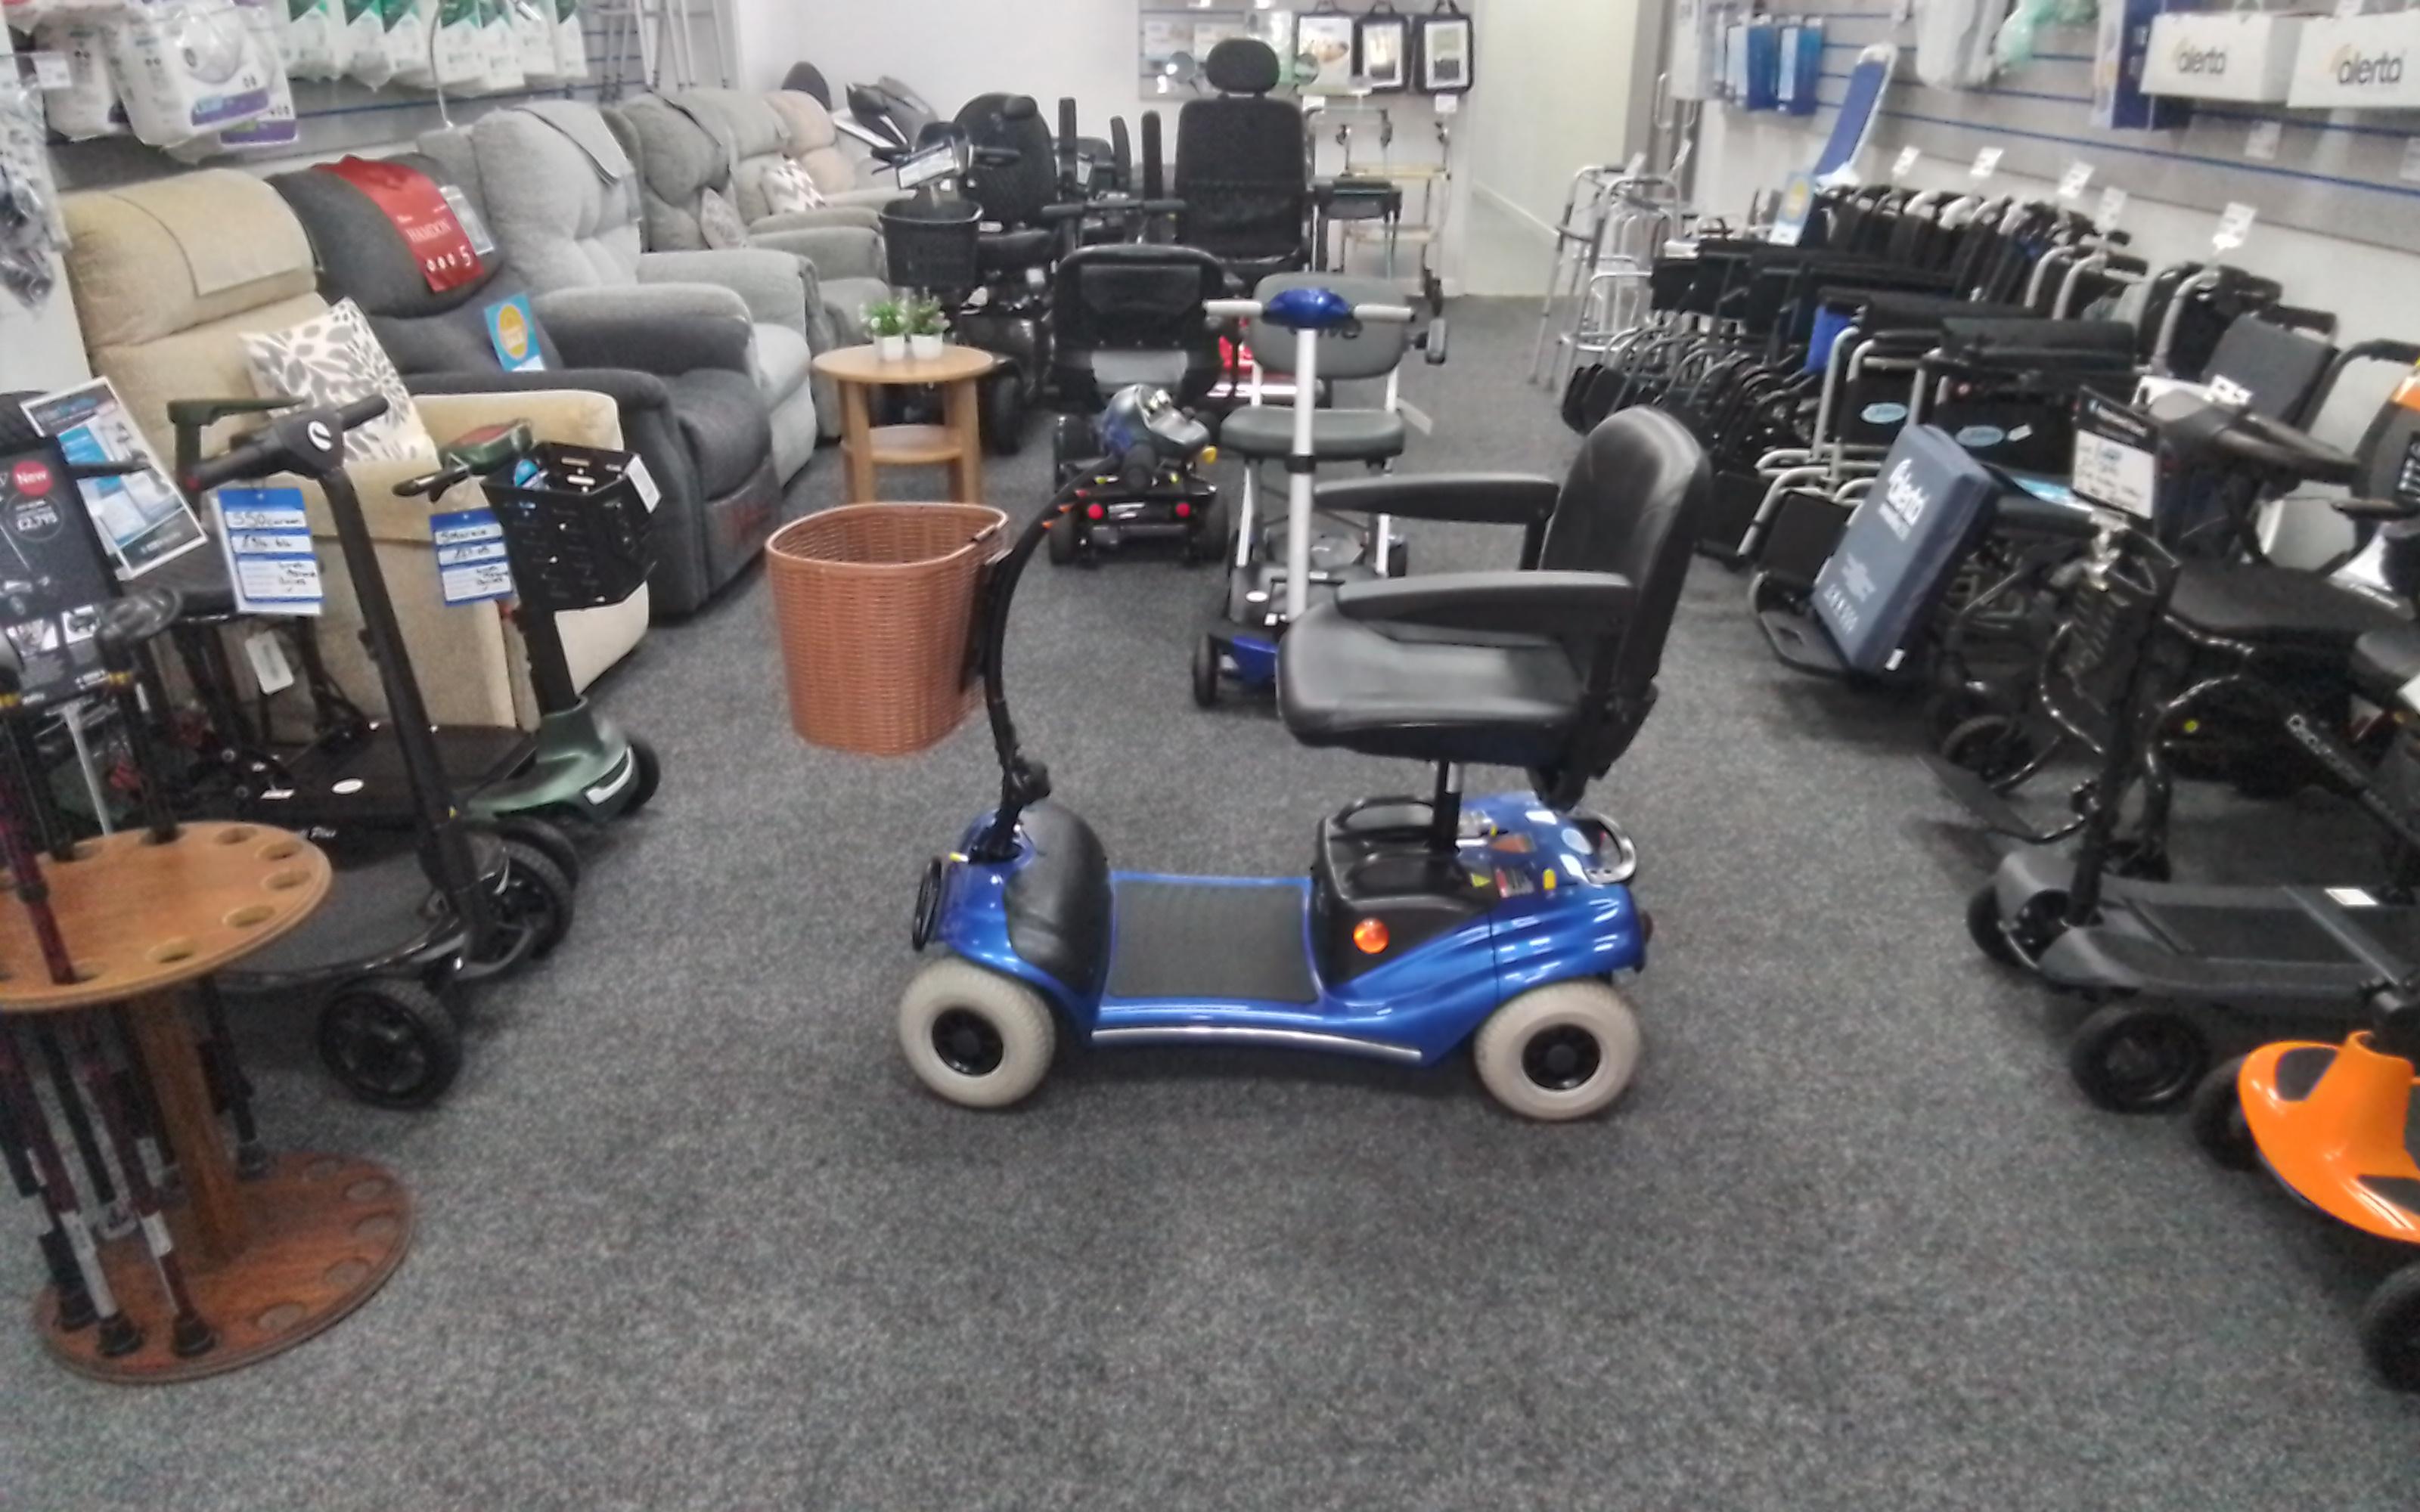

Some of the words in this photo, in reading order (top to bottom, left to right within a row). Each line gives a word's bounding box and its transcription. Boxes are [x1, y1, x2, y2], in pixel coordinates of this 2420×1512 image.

[2178, 44, 2226, 74] alerta
[2338, 51, 2403, 85] alerta
[16, 469, 47, 485] New
